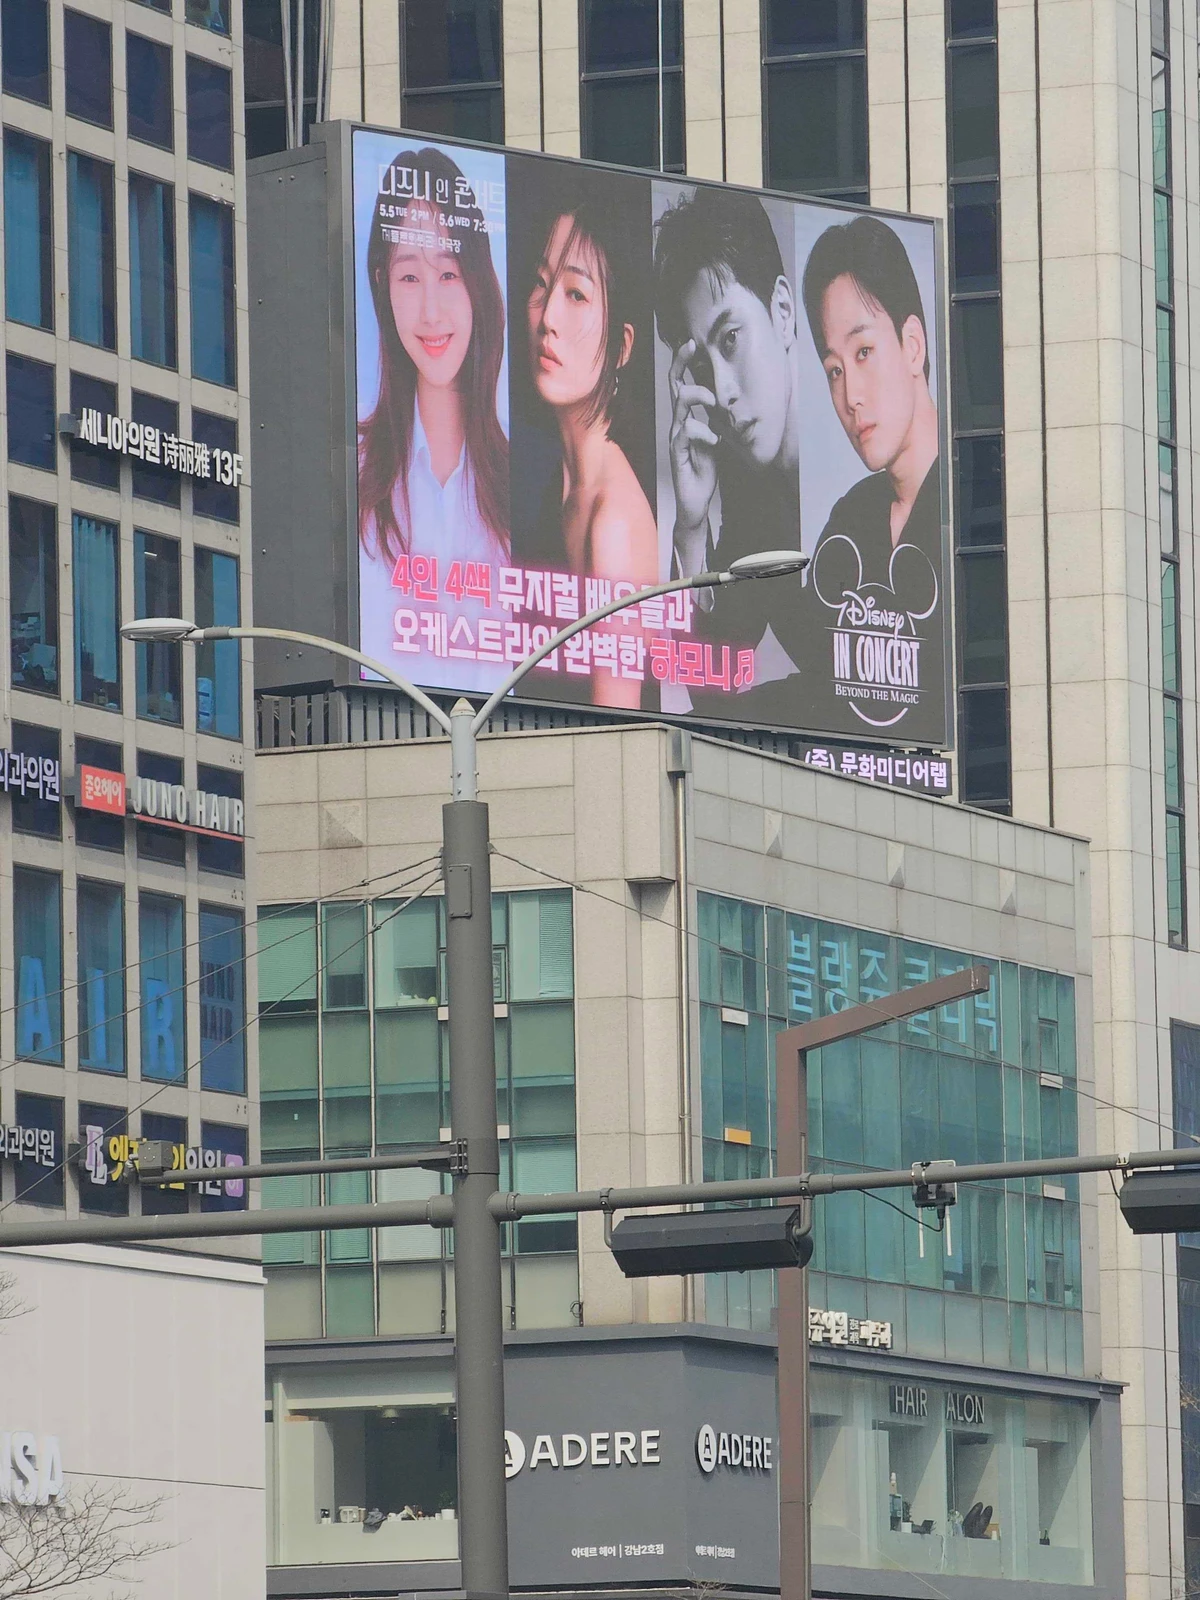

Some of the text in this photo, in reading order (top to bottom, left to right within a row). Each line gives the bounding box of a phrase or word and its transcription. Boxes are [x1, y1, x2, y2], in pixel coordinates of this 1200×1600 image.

[378, 164, 432, 202] 디즈니
[435, 178, 449, 204] 인
[80, 407, 243, 487] 세니아의원 诗丽雅 13F
[391, 554, 693, 633] 4인 4색 뮤지컬 배우들과
[392, 608, 730, 691] 오케스트라의 완벽한 하모니
[833, 632, 920, 688] IN CONCERT
[804, 748, 947, 788] (주) 문화미디어랩
[84, 773, 122, 807] 준오헤어
[131, 776, 244, 835] JUNO HAIR
[894, 1385, 928, 1417] HAIR
[530, 1430, 661, 1469] ADERE
[717, 1432, 773, 1469] ADERE
[571, 1543, 665, 1559] 아데르 헤어 강남2호점
